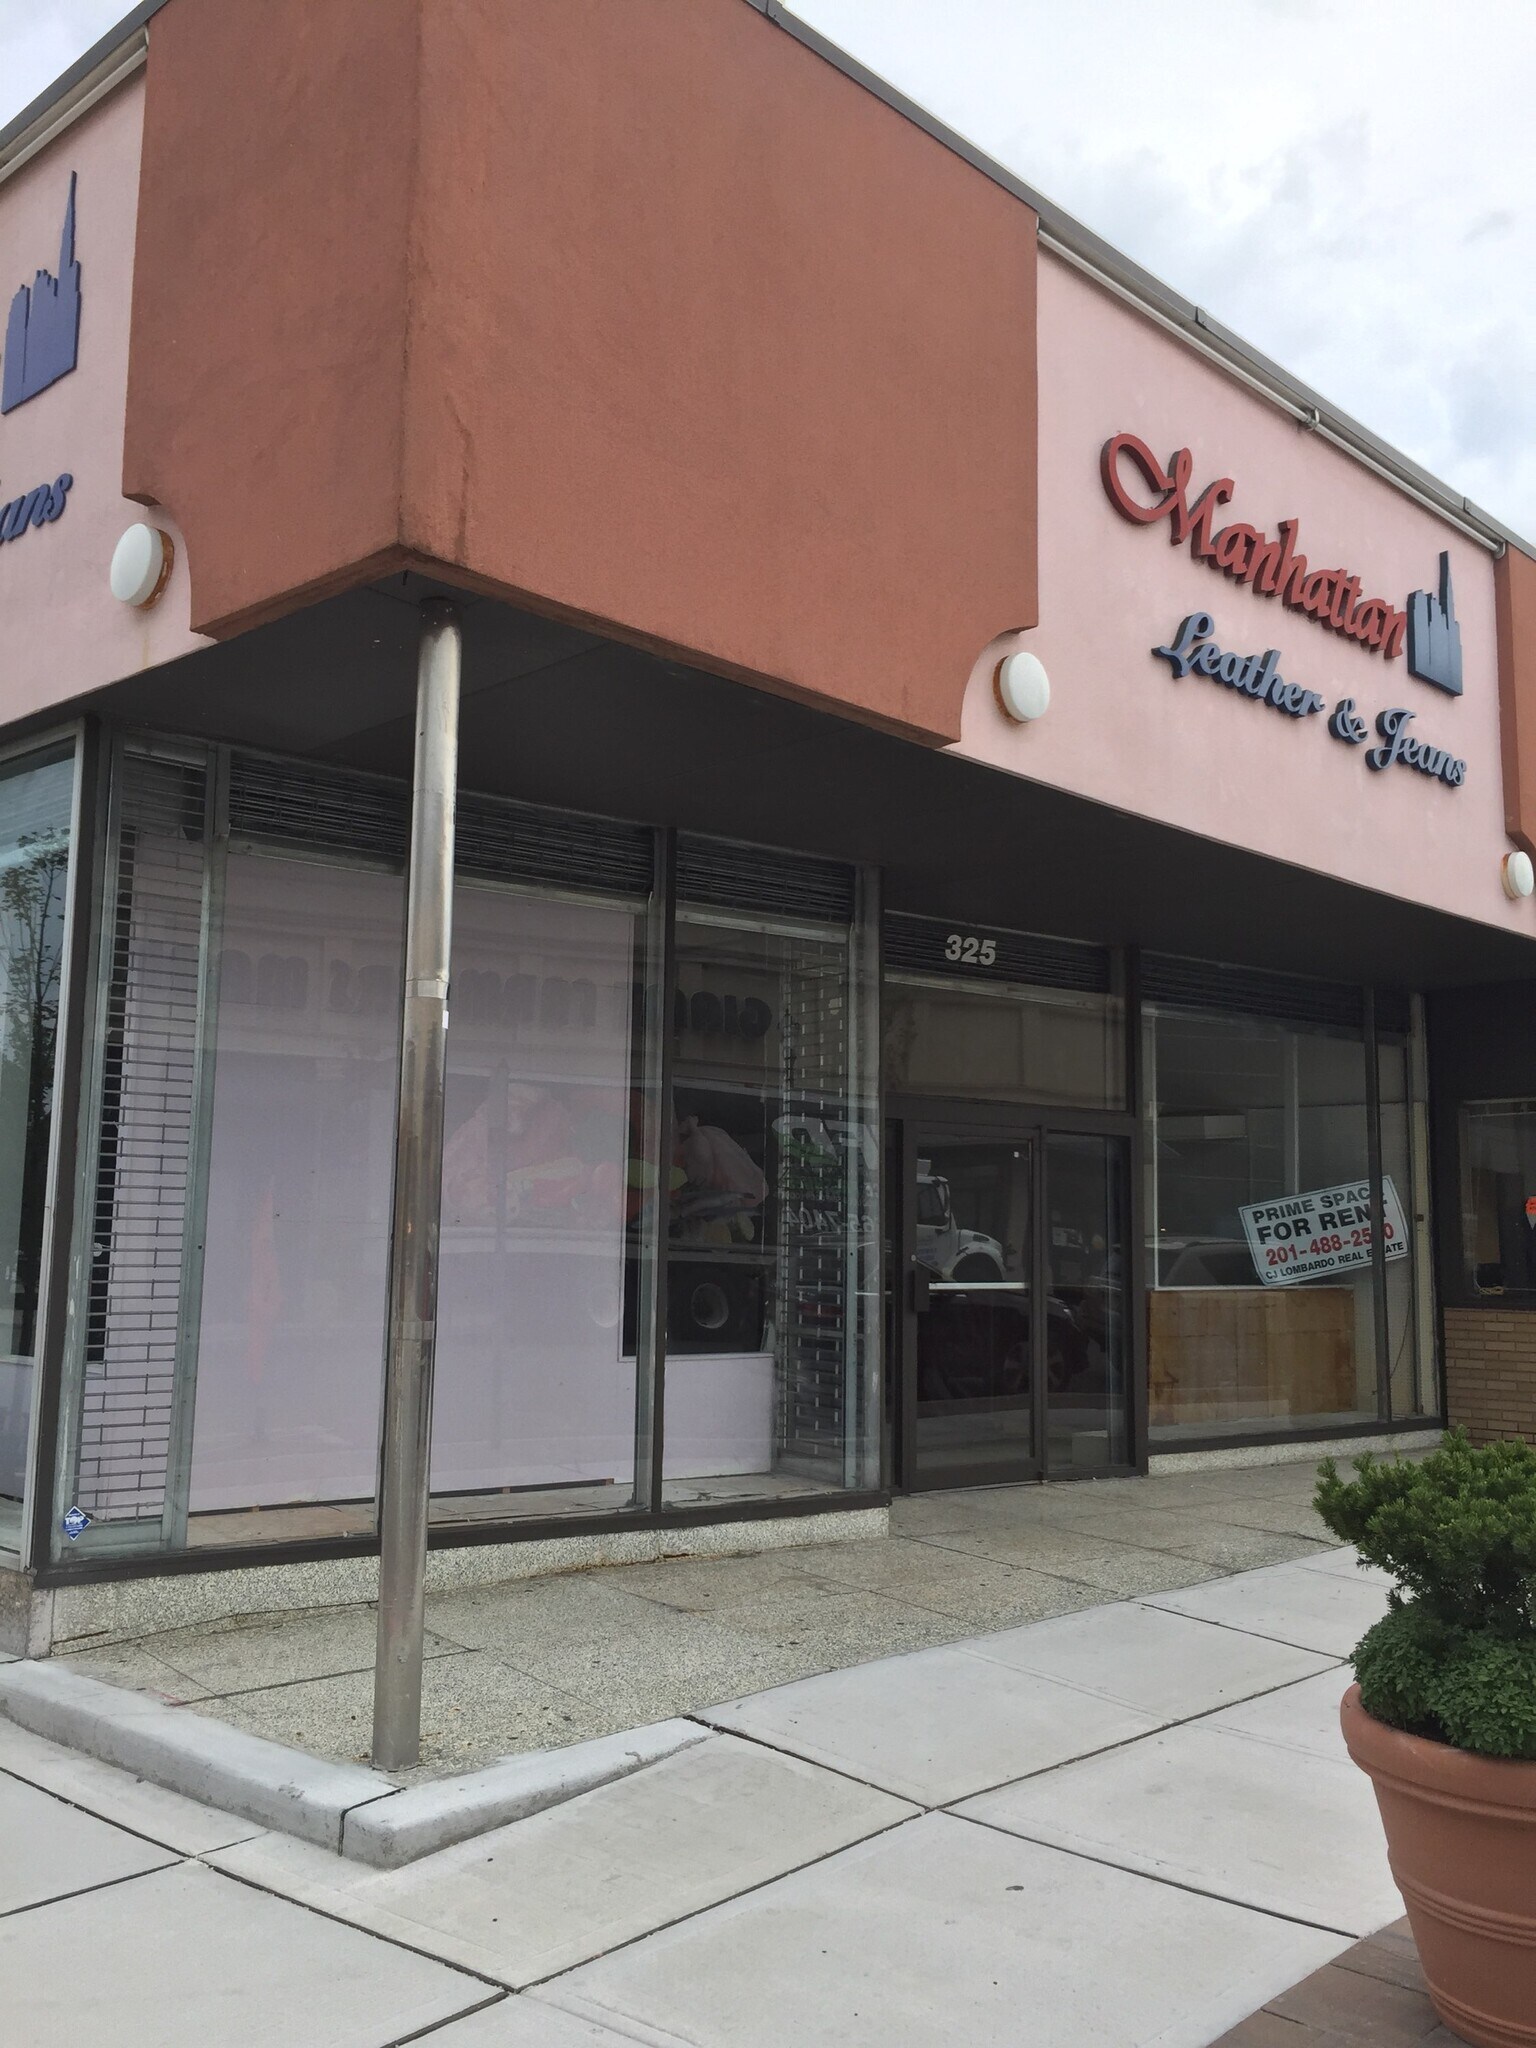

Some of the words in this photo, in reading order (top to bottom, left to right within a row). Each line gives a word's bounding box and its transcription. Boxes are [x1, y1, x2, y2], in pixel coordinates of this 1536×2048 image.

[1100, 433, 1407, 658] Manhattan
[1151, 612, 1325, 717] Leather
[1328, 697, 1369, 744] &
[1365, 707, 1467, 787] Jeans
[945, 934, 997, 966] 325
[1252, 1199, 1315, 1224] PRIME
[1319, 1186, 1386, 1209] SPAC
[1256, 1217, 1312, 1245] FOR
[1265, 1222, 1394, 1266] 201-488-250
[1265, 1269, 1278, 1280] CJ
[1280, 1258, 1335, 1277] LOMBARDO
[1338, 1250, 1364, 1265] REAL
[1366, 1241, 1404, 1262] EATE
